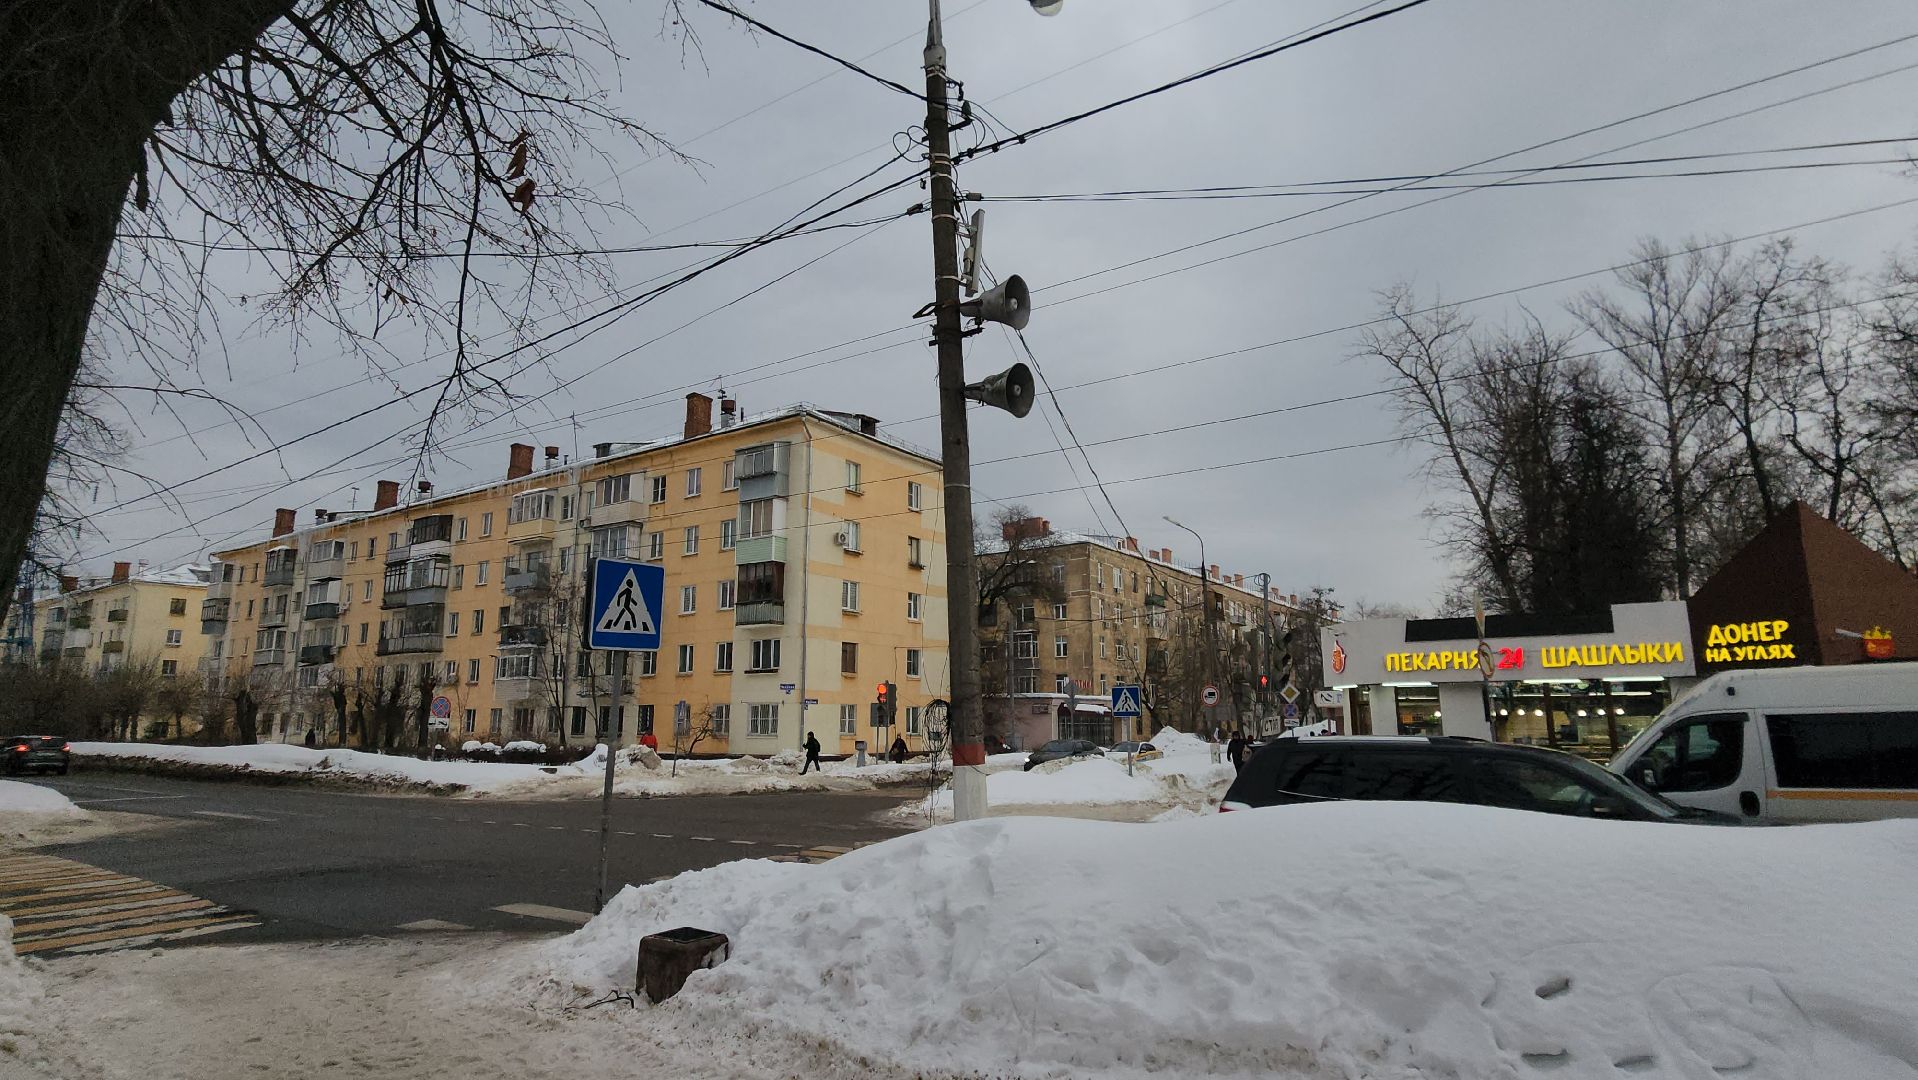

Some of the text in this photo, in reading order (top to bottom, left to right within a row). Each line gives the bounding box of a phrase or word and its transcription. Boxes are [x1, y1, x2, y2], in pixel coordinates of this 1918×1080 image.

[1707, 620, 1789, 647] ДОНЕР
[1385, 640, 1684, 672] ПЕКАРНЯ 24 ШАШЛЫКИ
[1705, 644, 1796, 662] НА УГЛЯХ
